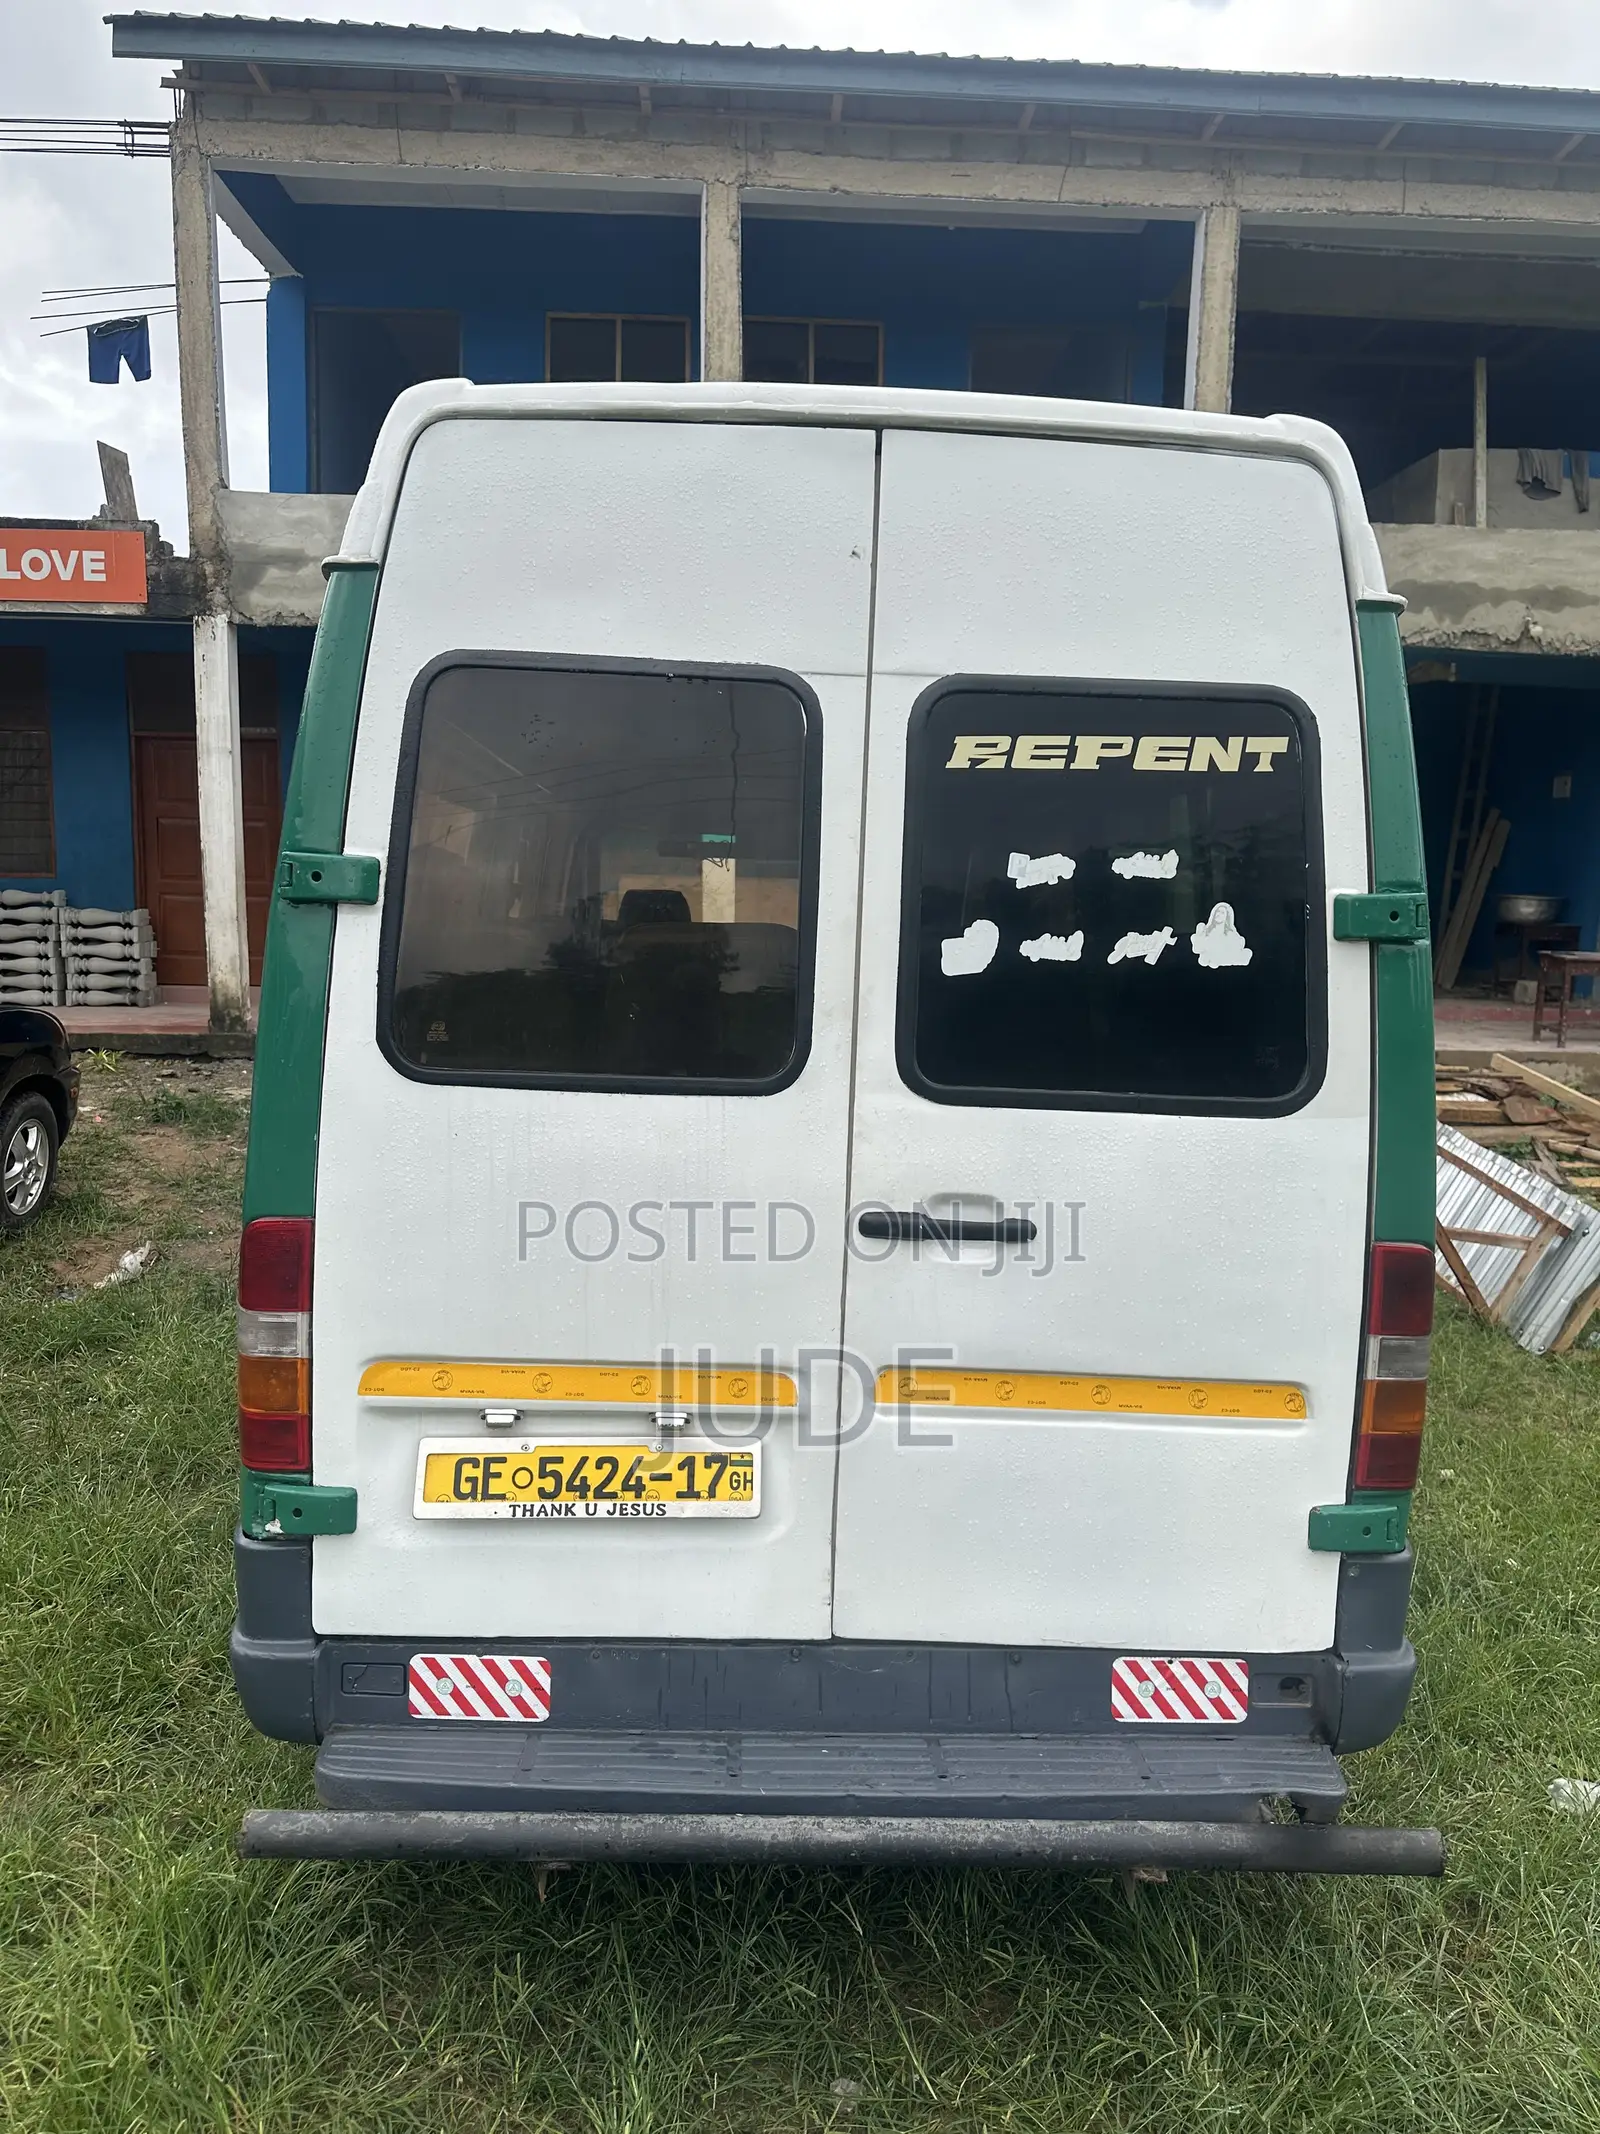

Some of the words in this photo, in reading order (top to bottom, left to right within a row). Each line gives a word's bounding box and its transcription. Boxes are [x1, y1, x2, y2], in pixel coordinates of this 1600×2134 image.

[0, 549, 106, 581] LOVE
[945, 735, 1289, 772] REPENT
[453, 1457, 507, 1500] GE
[538, 1455, 728, 1499] 5424-17
[729, 1471, 753, 1491] GH
[509, 1503, 576, 1517] THANK
[585, 1503, 598, 1516] U
[607, 1503, 667, 1516] JESUS
